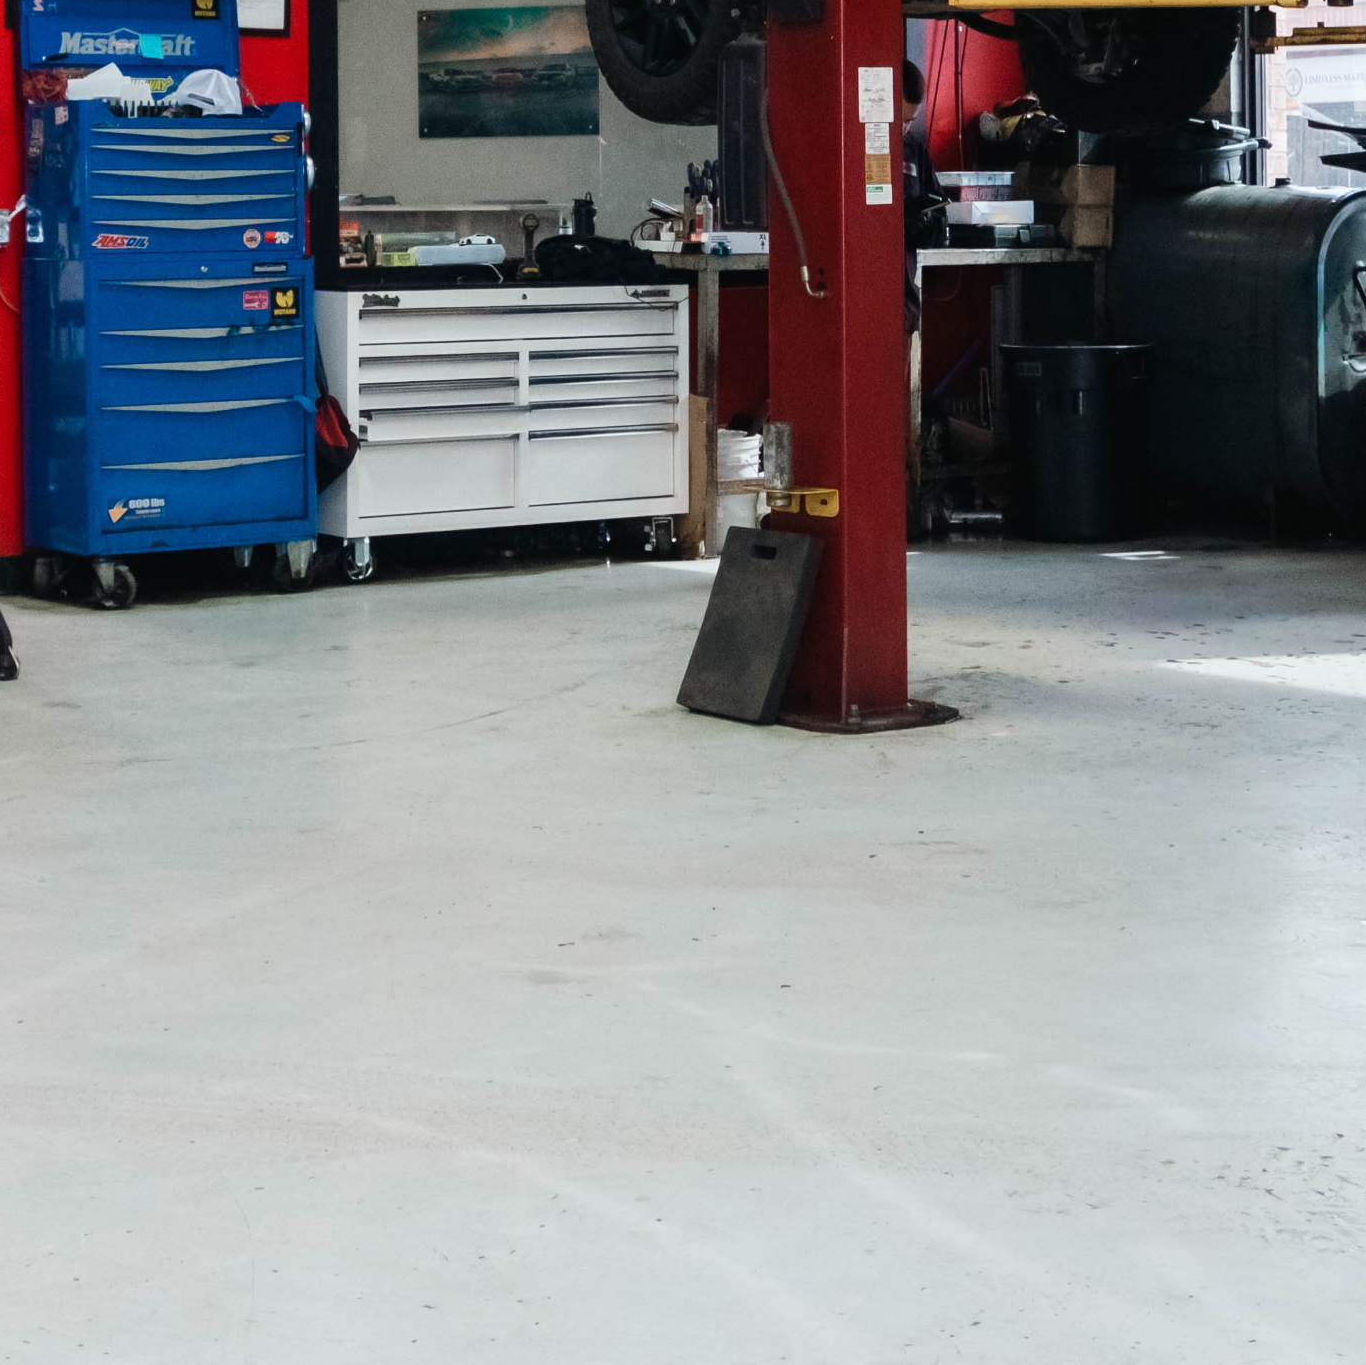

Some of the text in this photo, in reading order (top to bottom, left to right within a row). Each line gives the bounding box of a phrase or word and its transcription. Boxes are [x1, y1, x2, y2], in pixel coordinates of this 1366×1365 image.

[59, 31, 196, 56] Masteraft
[1304, 74, 1343, 85] LIMITLESS
[95, 236, 148, 248] AMSOIL
[128, 498, 150, 509] 800
